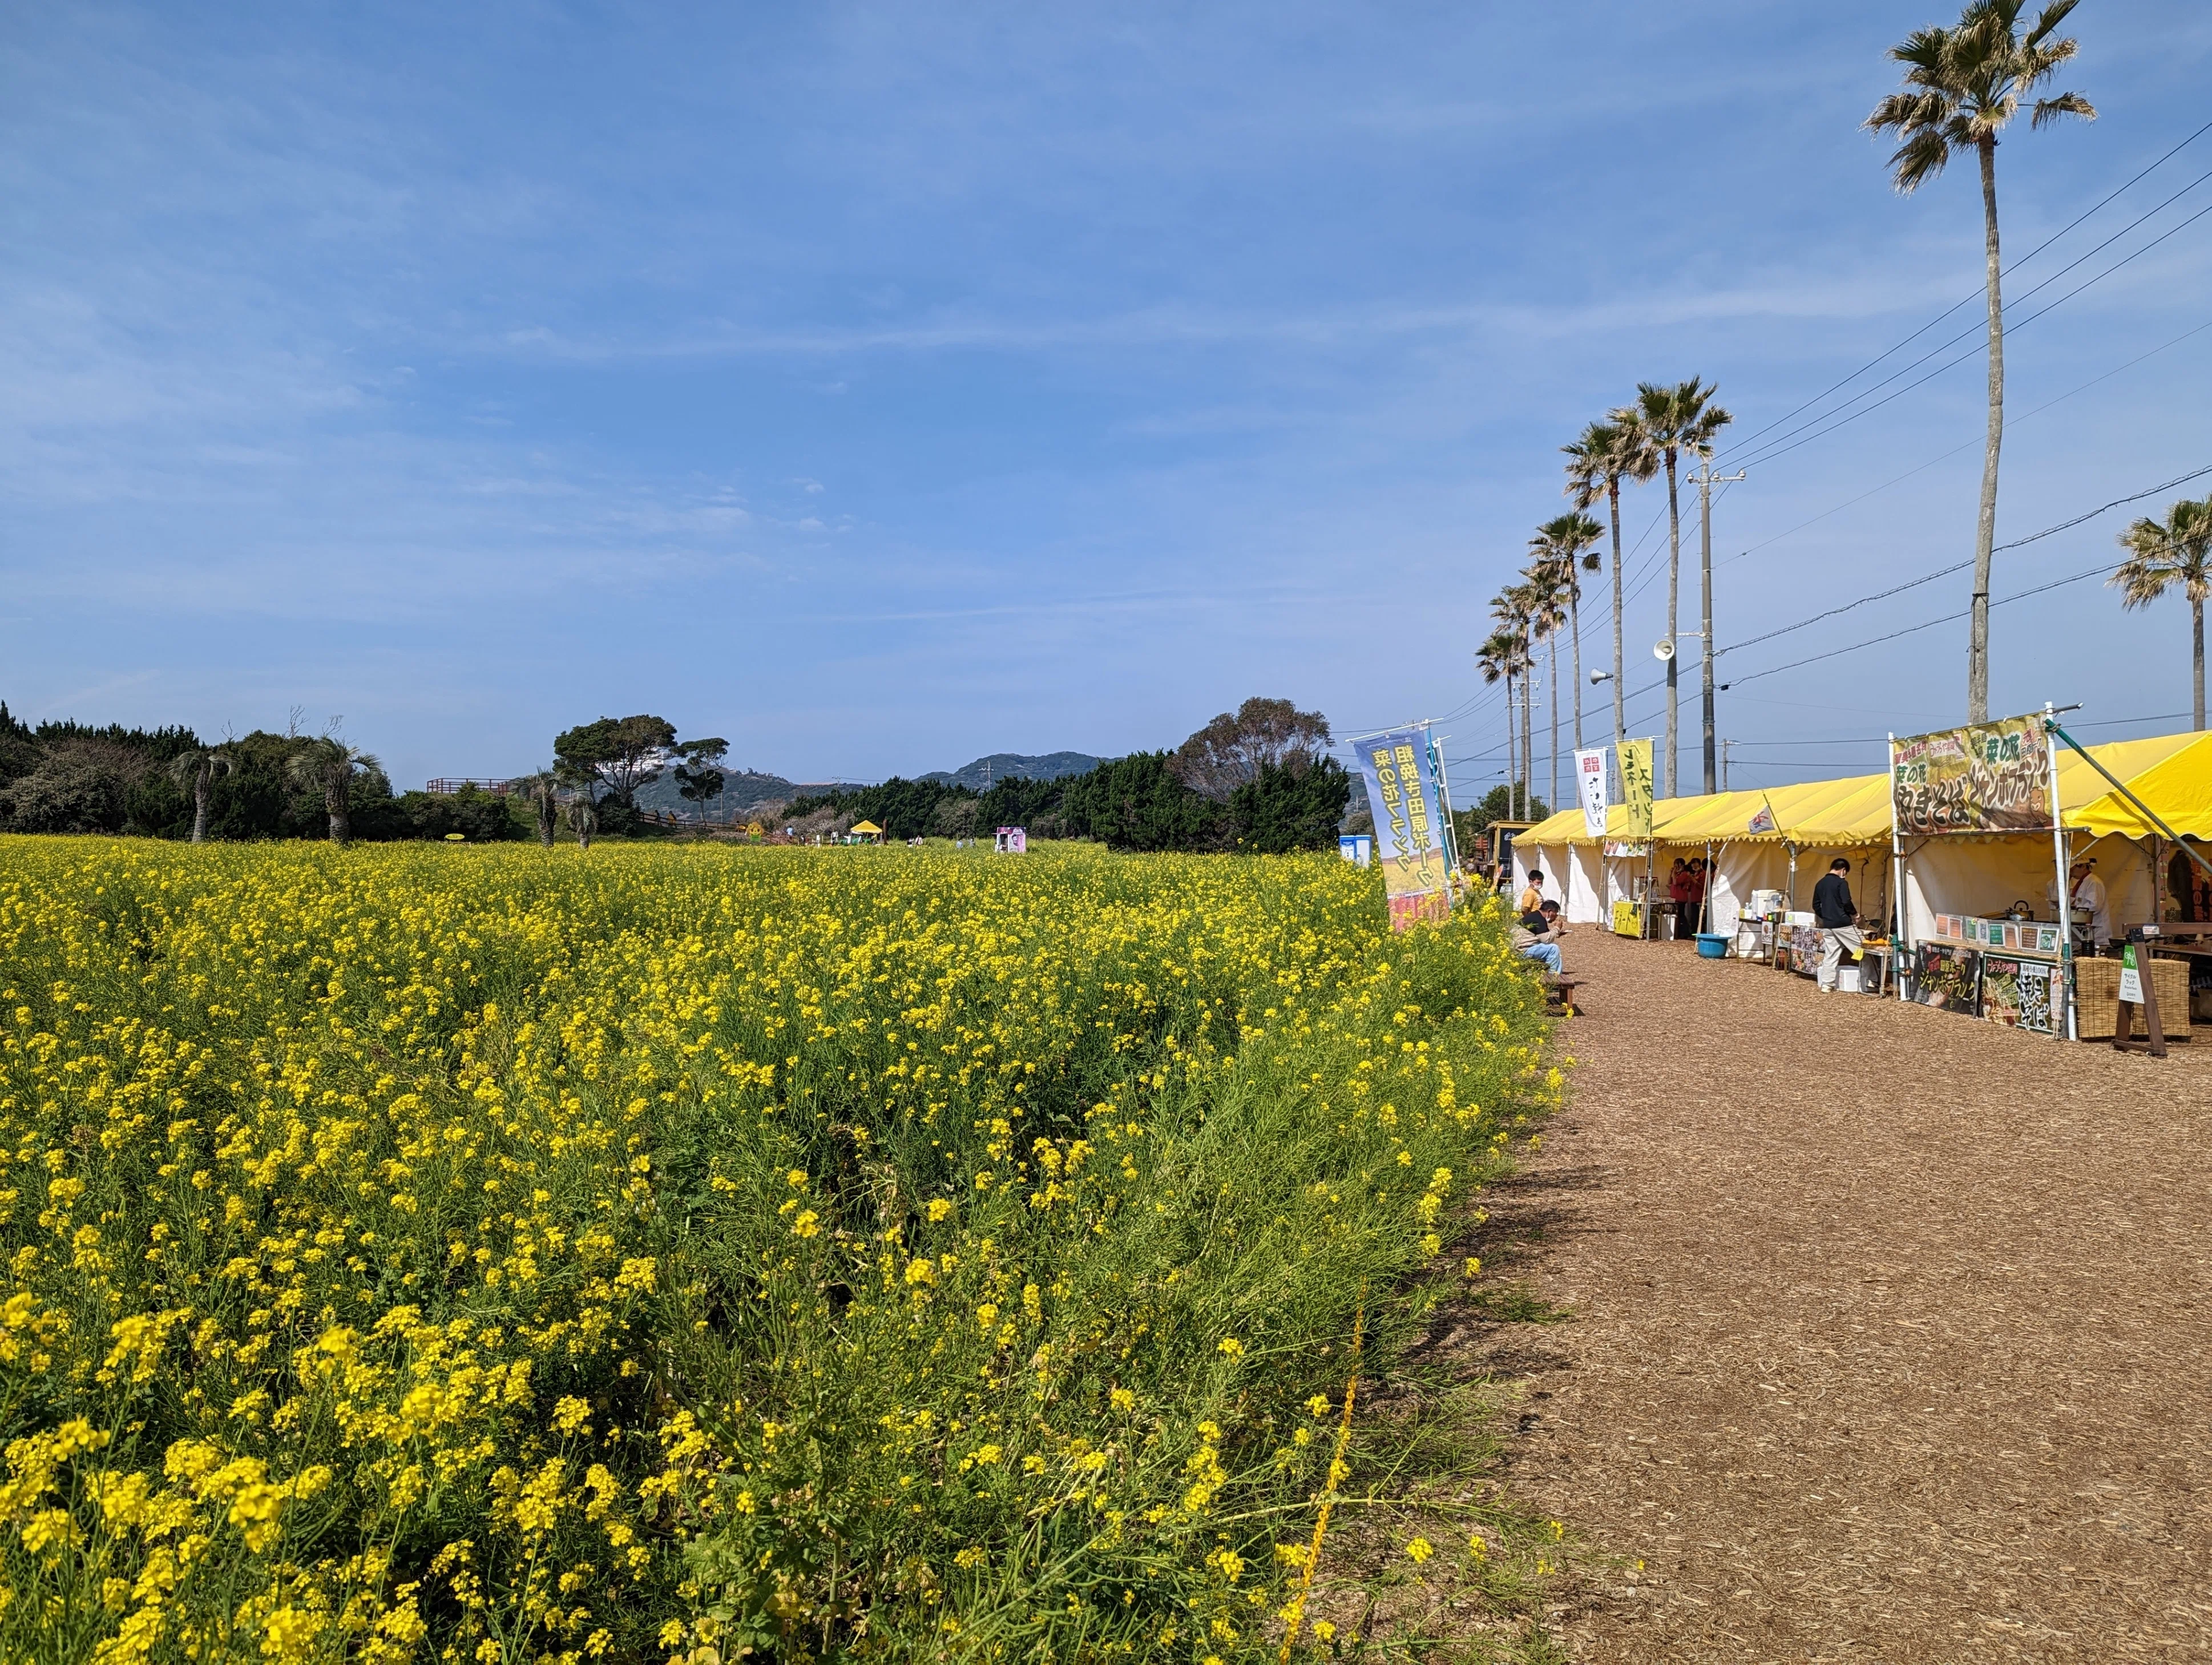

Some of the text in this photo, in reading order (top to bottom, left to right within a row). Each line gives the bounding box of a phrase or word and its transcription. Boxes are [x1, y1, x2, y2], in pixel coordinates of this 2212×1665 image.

[1987, 734, 2020, 765] 菜の花
[1896, 764, 1927, 784] 菜の花
[1970, 749, 2048, 807] ジャンボフランク
[1898, 775, 1969, 826] やきそば
[1940, 960, 1966, 976] 田原ポーク
[1919, 970, 1975, 1000] ジャンボフランク
[2016, 973, 2044, 1004] 焼き
[2020, 1002, 2048, 1030] そば
